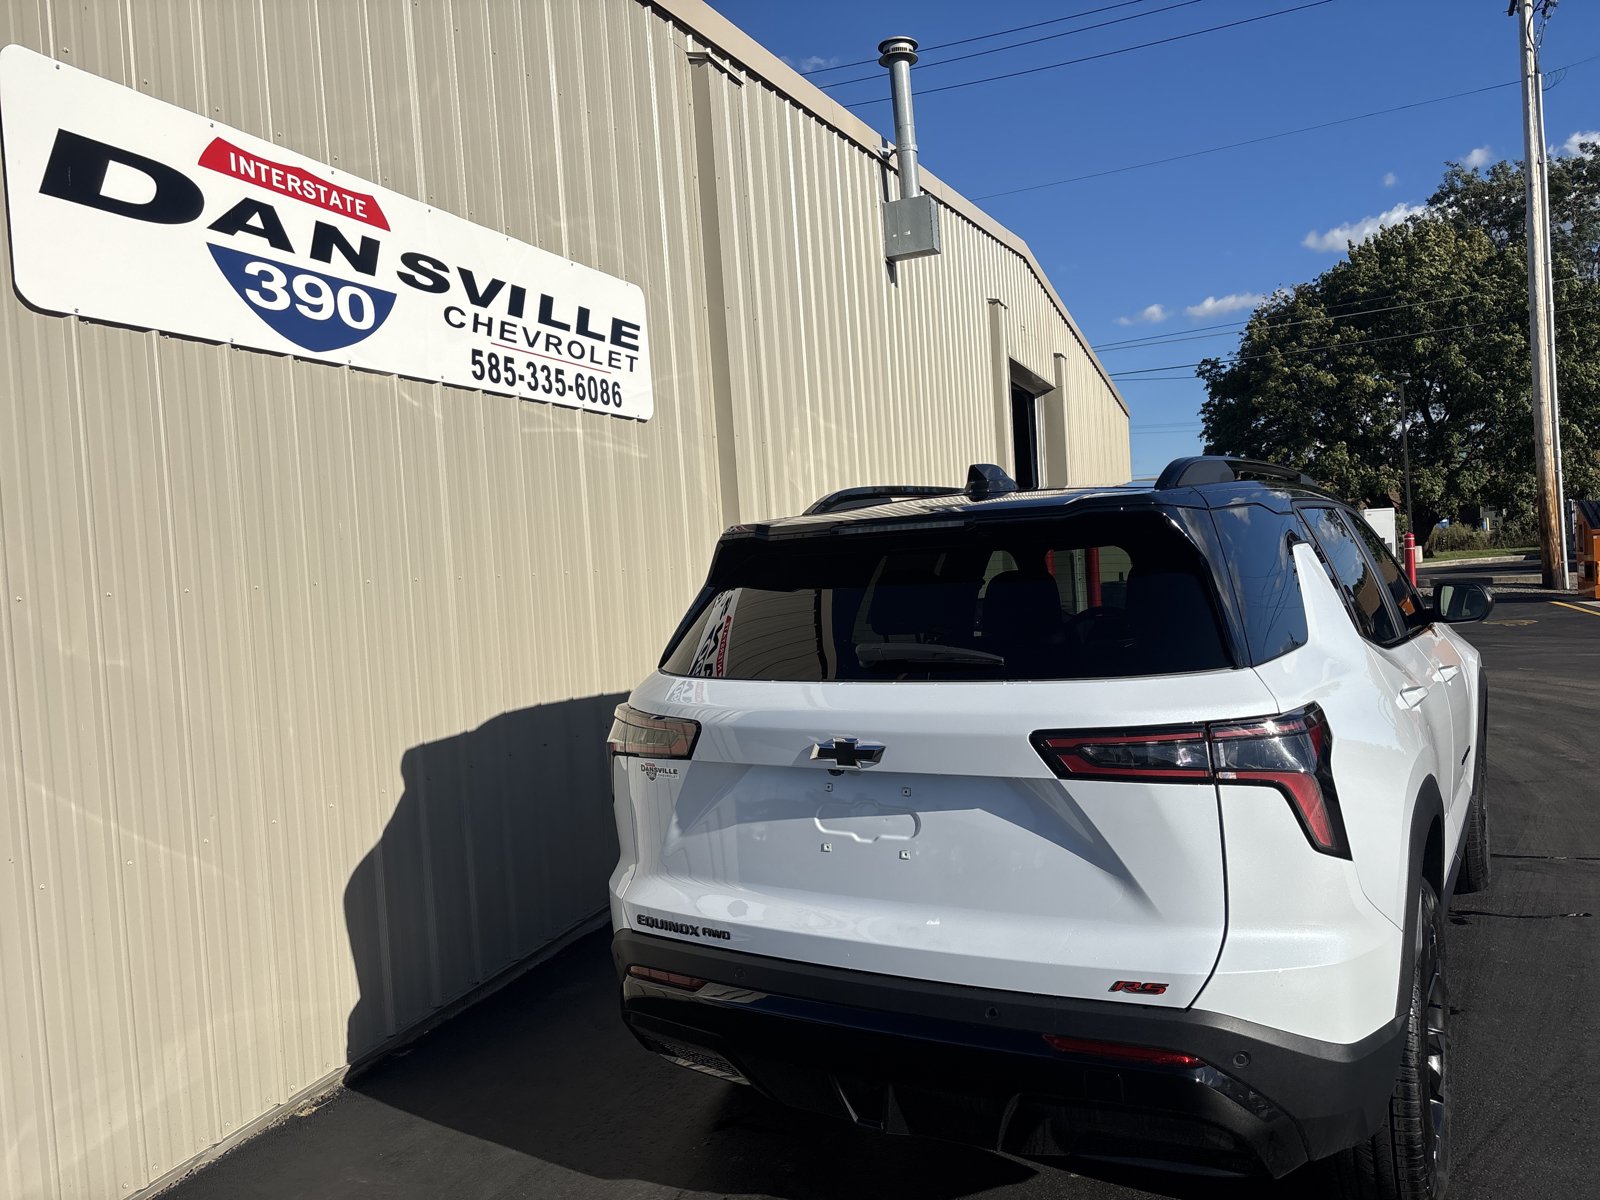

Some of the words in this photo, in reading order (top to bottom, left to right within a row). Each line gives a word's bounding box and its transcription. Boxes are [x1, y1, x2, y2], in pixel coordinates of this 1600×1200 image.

[229, 151, 368, 219] INTERSTATE
[38, 128, 641, 352] DANSVILLE
[244, 261, 376, 331] 390
[443, 305, 639, 373] CHEVROLET
[471, 348, 623, 408] 585-335-6086
[640, 763, 679, 775] DANSVILLE
[636, 914, 700, 937] EQUINOX
[701, 926, 731, 941] AWD
[1107, 980, 1170, 996] RS
